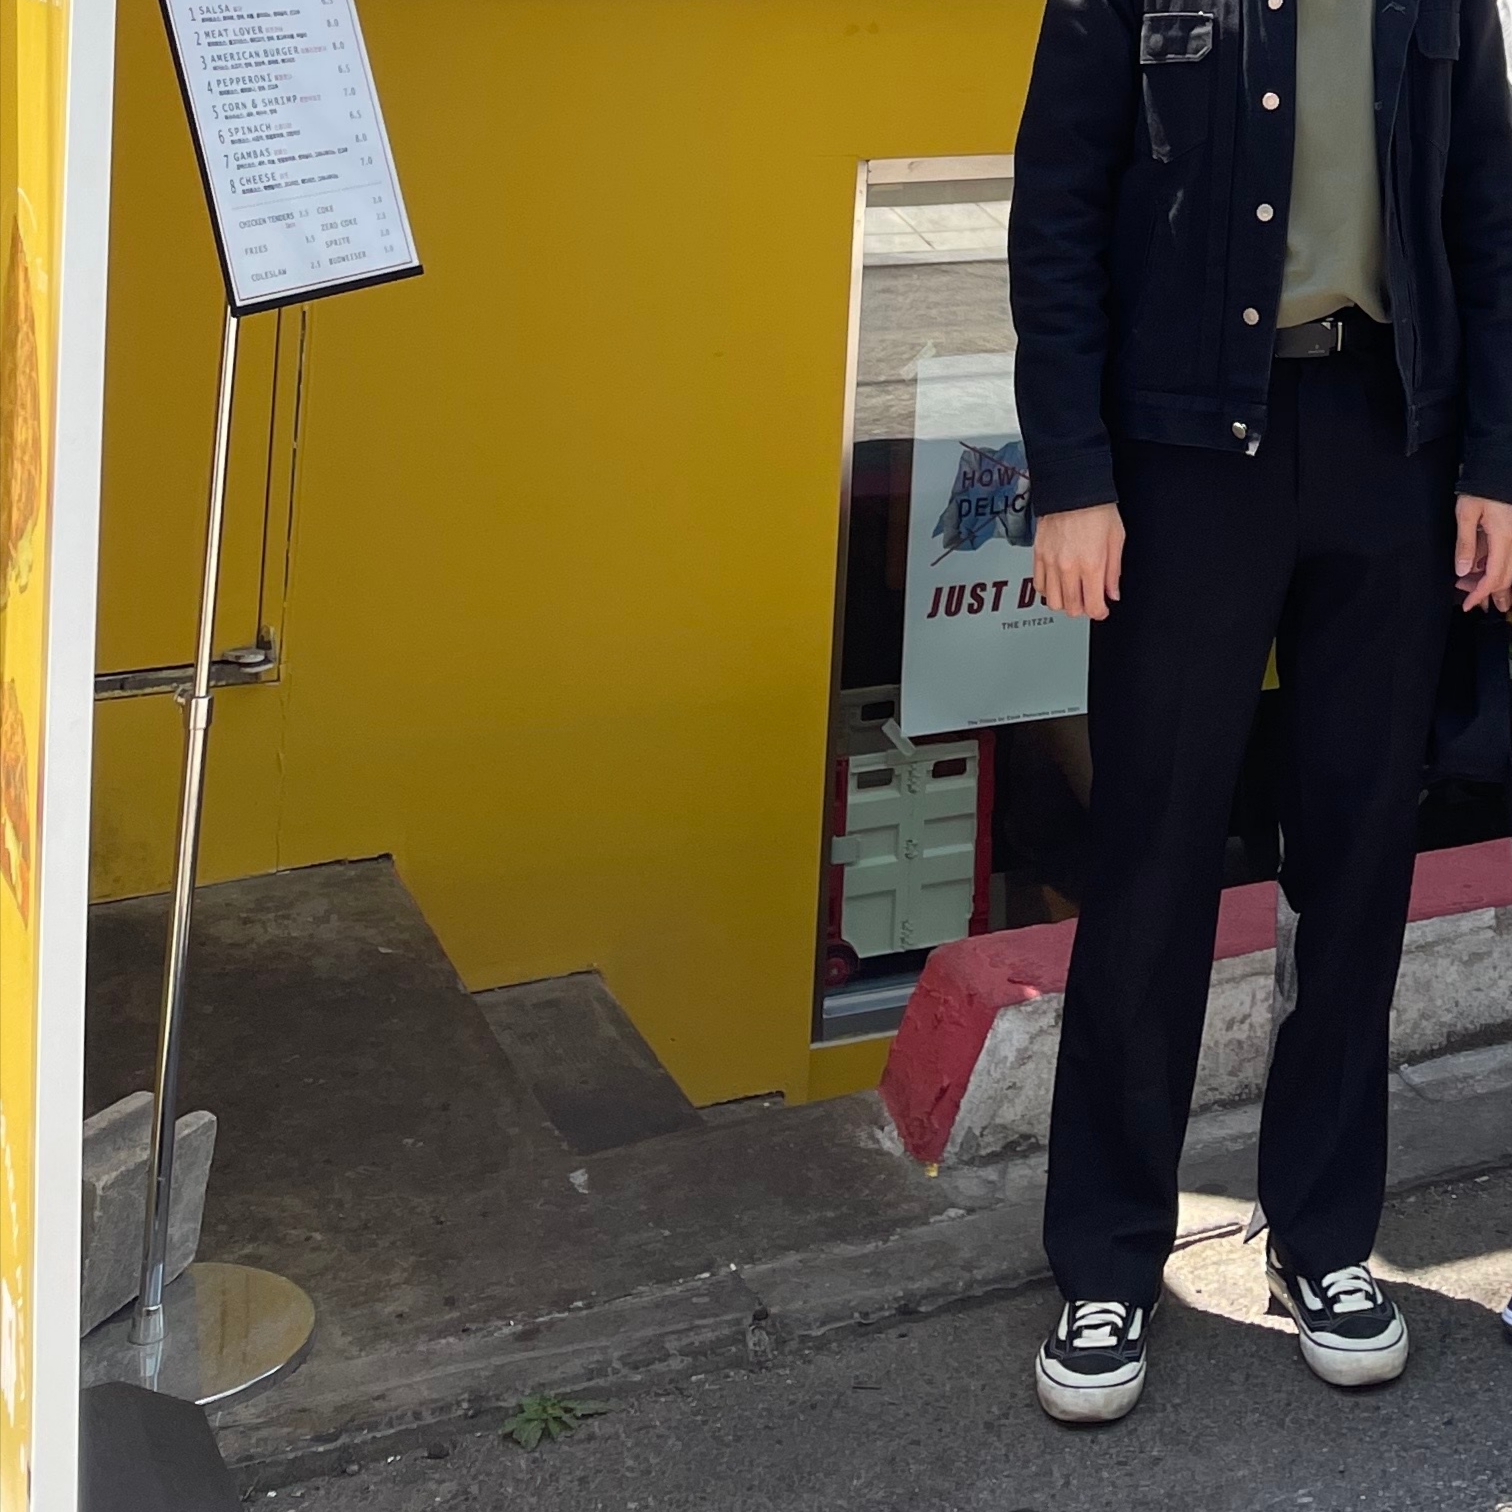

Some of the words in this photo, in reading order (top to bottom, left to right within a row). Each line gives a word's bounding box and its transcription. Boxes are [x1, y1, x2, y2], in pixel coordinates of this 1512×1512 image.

[188, 7, 196, 21] 1
[198, 4, 230, 15] SALSA
[194, 31, 201, 46] 2
[204, 28, 229, 39] MEAT
[233, 26, 264, 37] LOVER
[200, 55, 208, 70] 3
[210, 49, 261, 63] AMERICAN
[263, 45, 300, 58] BURGER
[207, 80, 214, 94] 4
[216, 73, 272, 88] PEPPERONI
[222, 101, 247, 113] CORN
[261, 94, 298, 108] SHRIMP
[218, 129, 226, 145] 6
[227, 123, 272, 137] SPINACH
[233, 147, 272, 162] GAMBAS
[239, 172, 277, 186] CHEESE
[244, 244, 268, 256] FRIES
[962, 466, 1016, 489] HOW
[958, 493, 1026, 519] DELIC
[926, 579, 1009, 619] JUST
[1017, 576, 1047, 609] D
[1002, 620, 1020, 631] THE
[1022, 616, 1054, 628] FITZZA
